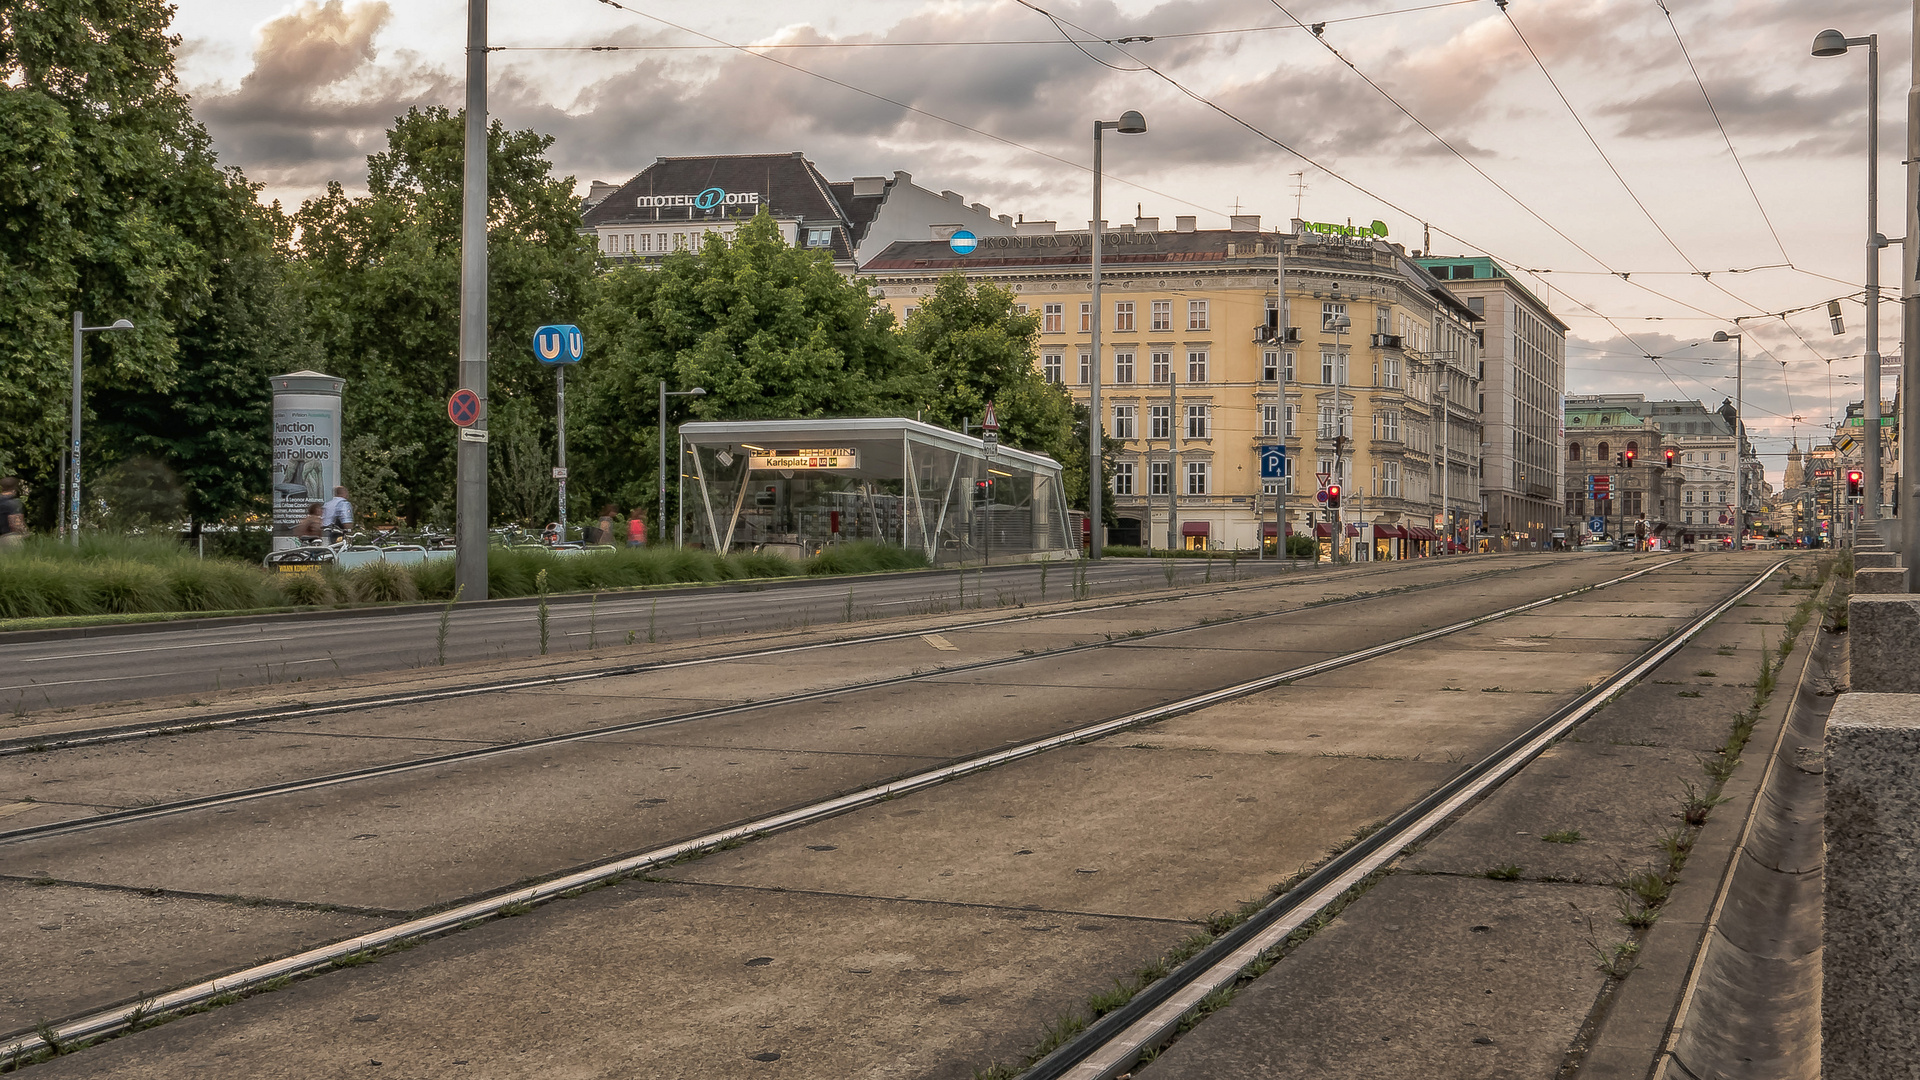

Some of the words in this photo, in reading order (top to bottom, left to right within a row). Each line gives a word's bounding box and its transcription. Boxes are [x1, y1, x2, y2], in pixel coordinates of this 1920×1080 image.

[637, 194, 692, 208] MOTEL
[726, 192, 759, 205] ONE
[1304, 221, 1374, 238] MERKUR
[983, 235, 1060, 248] KONICA
[539, 333, 560, 360] U
[569, 332, 581, 358] U
[275, 421, 315, 433] Function
[294, 434, 331, 448] Vision,
[287, 448, 329, 460] Follows
[766, 457, 808, 468] Karlsplatz
[1269, 456, 1279, 472] P
[1594, 521, 1601, 531] P
